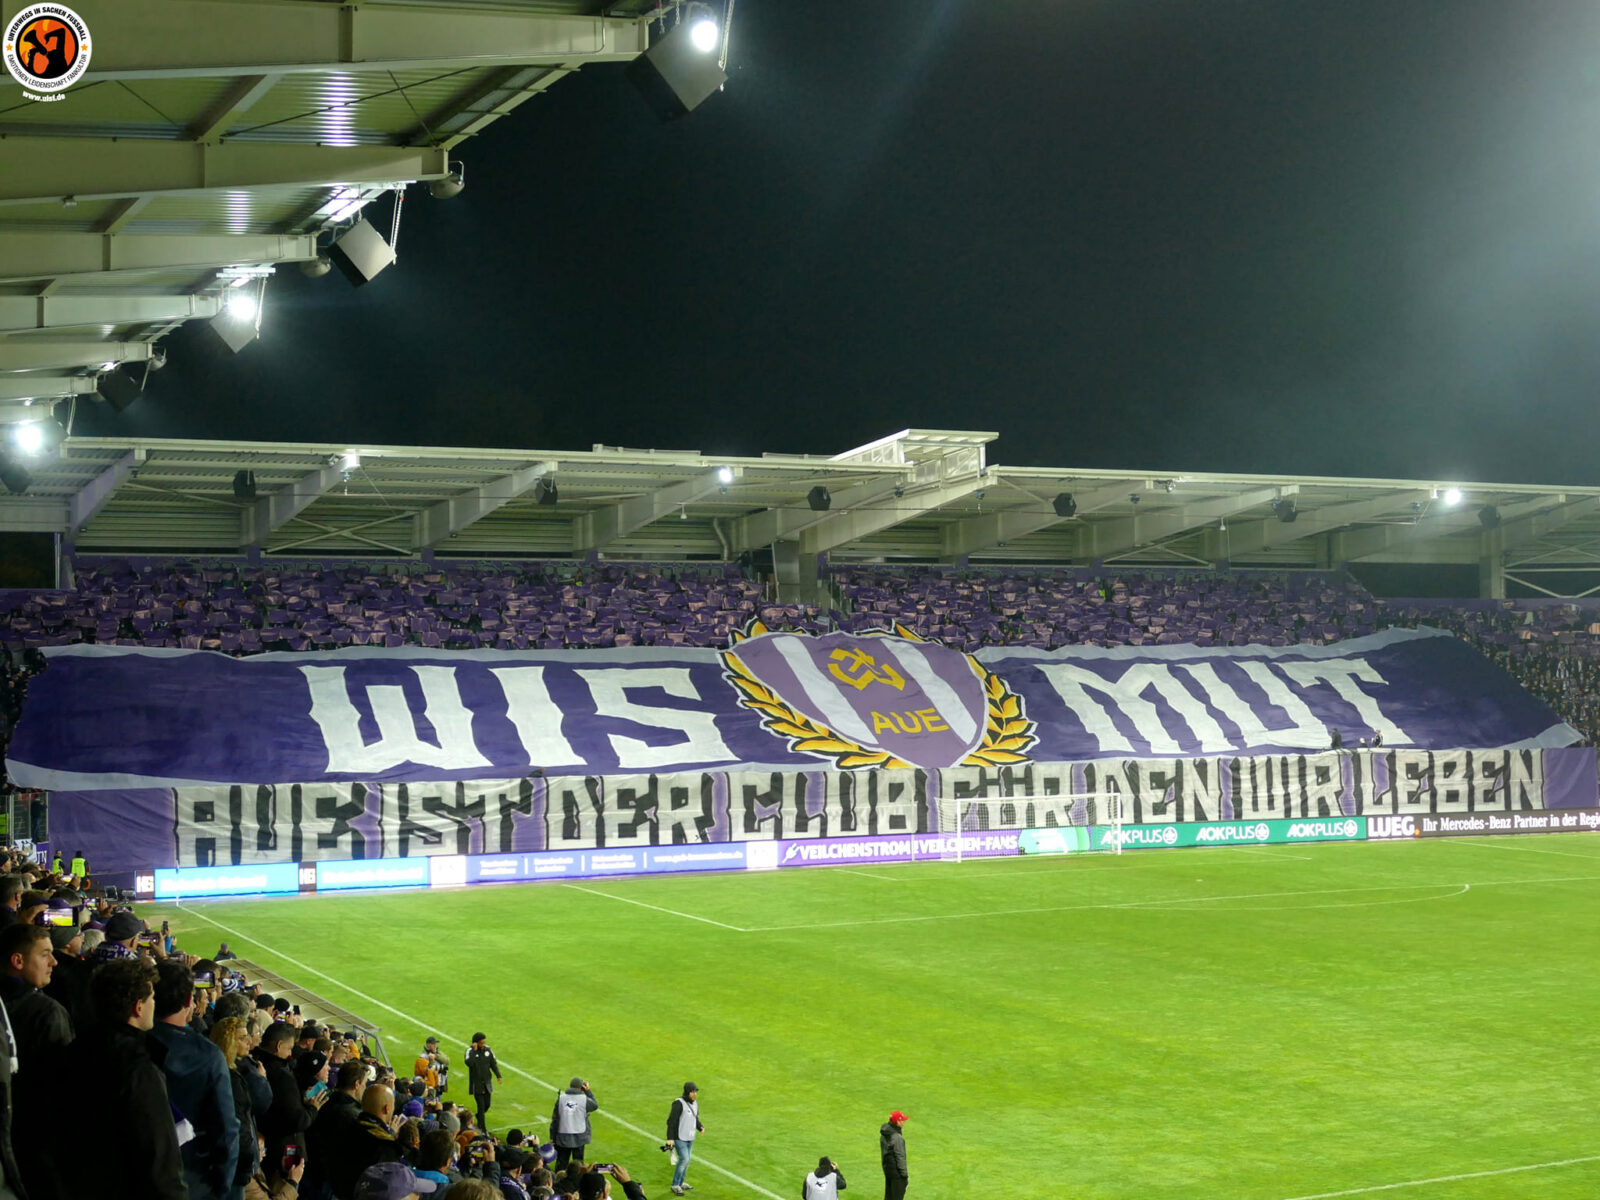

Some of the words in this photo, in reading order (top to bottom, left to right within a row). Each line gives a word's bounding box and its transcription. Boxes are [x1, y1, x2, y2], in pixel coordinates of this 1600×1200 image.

[871, 708, 950, 735] AUE
[176, 782, 362, 867] AUE
[380, 777, 531, 859] IST
[545, 772, 707, 850] DER
[728, 768, 917, 842] CLUB
[1092, 757, 1222, 826] DEN
[1238, 751, 1346, 819] WIR
[1358, 748, 1545, 816] LEBEN
[1423, 818, 1438, 831] Ihr
[1440, 816, 1511, 832] Mercedes-Benz
[1514, 814, 1548, 829] Partner
[1550, 813, 1560, 827] in
[1562, 812, 1578, 827] der
[1579, 811, 1600, 829] Regi
[800, 840, 911, 860] VEILCHENSTROM
[919, 835, 1017, 855] VEILCEN-FANS
